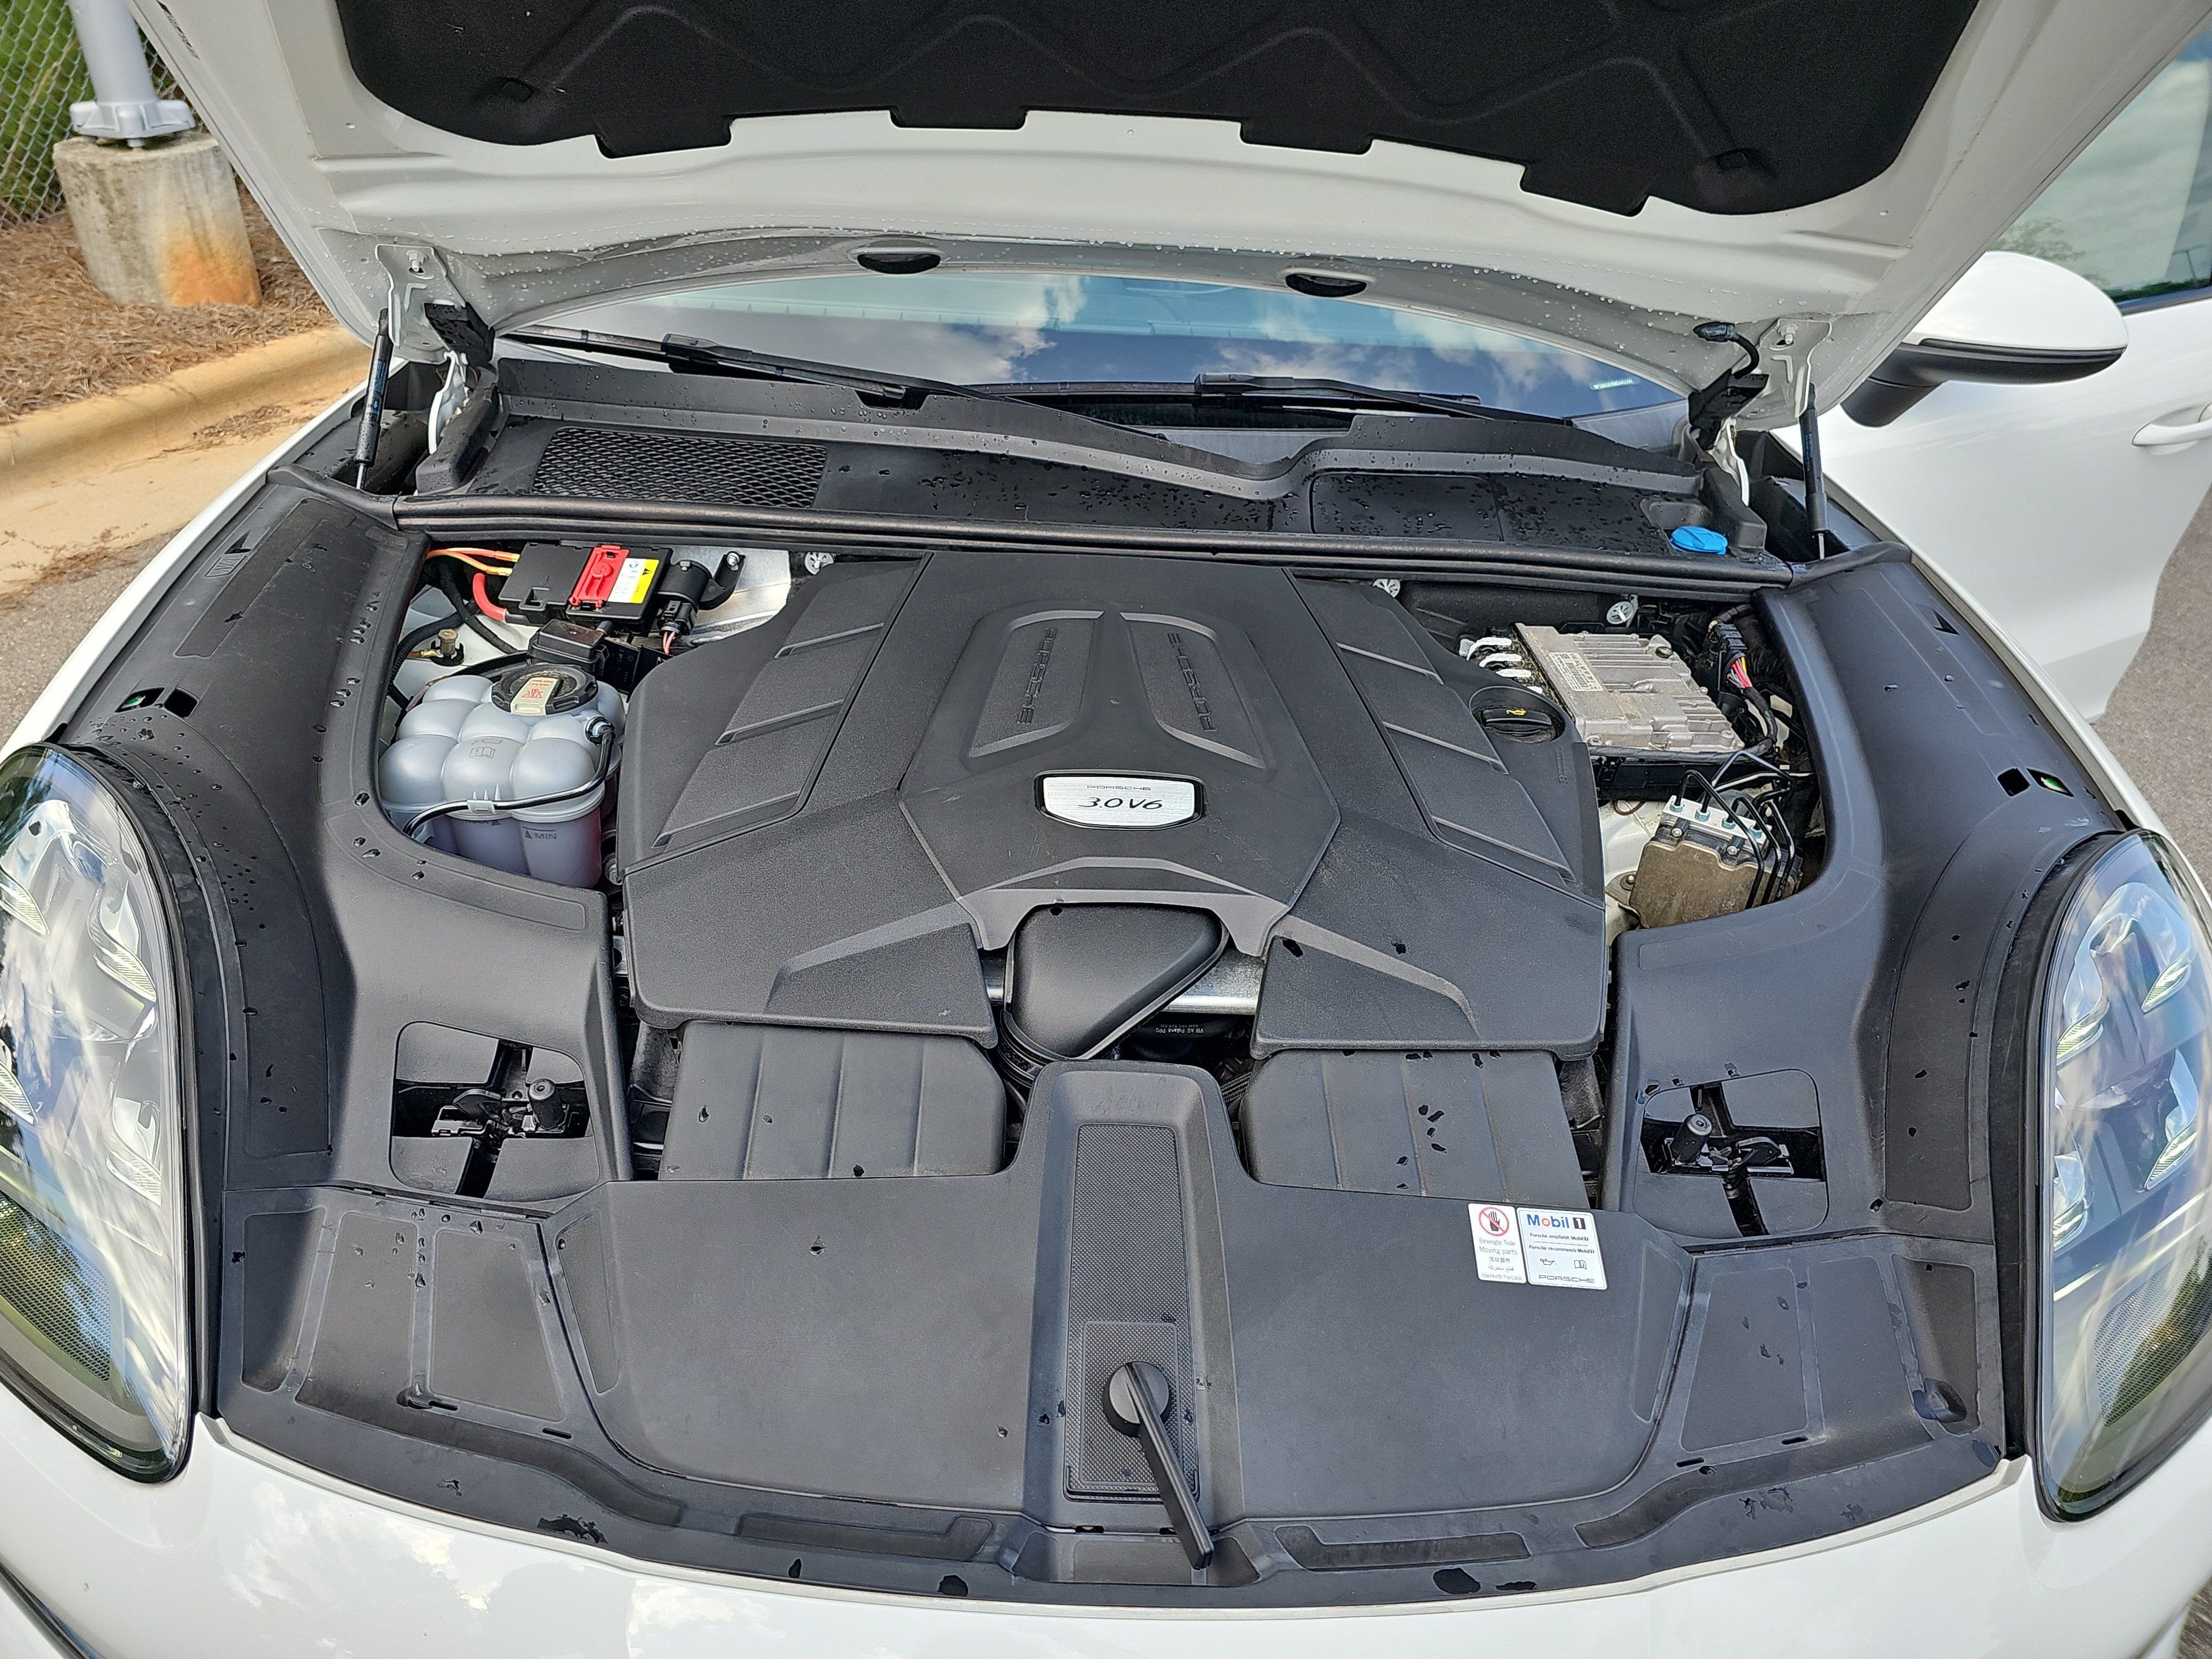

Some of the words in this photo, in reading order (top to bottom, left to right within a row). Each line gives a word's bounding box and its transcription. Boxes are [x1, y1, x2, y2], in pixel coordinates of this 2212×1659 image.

[1017, 628, 1058, 724] PORSCHE
[1167, 633, 1217, 732] PORSCHE
[1078, 797, 1123, 808] 3.0
[1129, 798, 1163, 809] V6
[1527, 1214, 1570, 1229] Mobil
[1574, 1218, 1584, 1229] 1
[1479, 1238, 1502, 1246] Bewegte
[1479, 1246, 1501, 1255] Moving
[1539, 1275, 1595, 1283] PORSCHE
